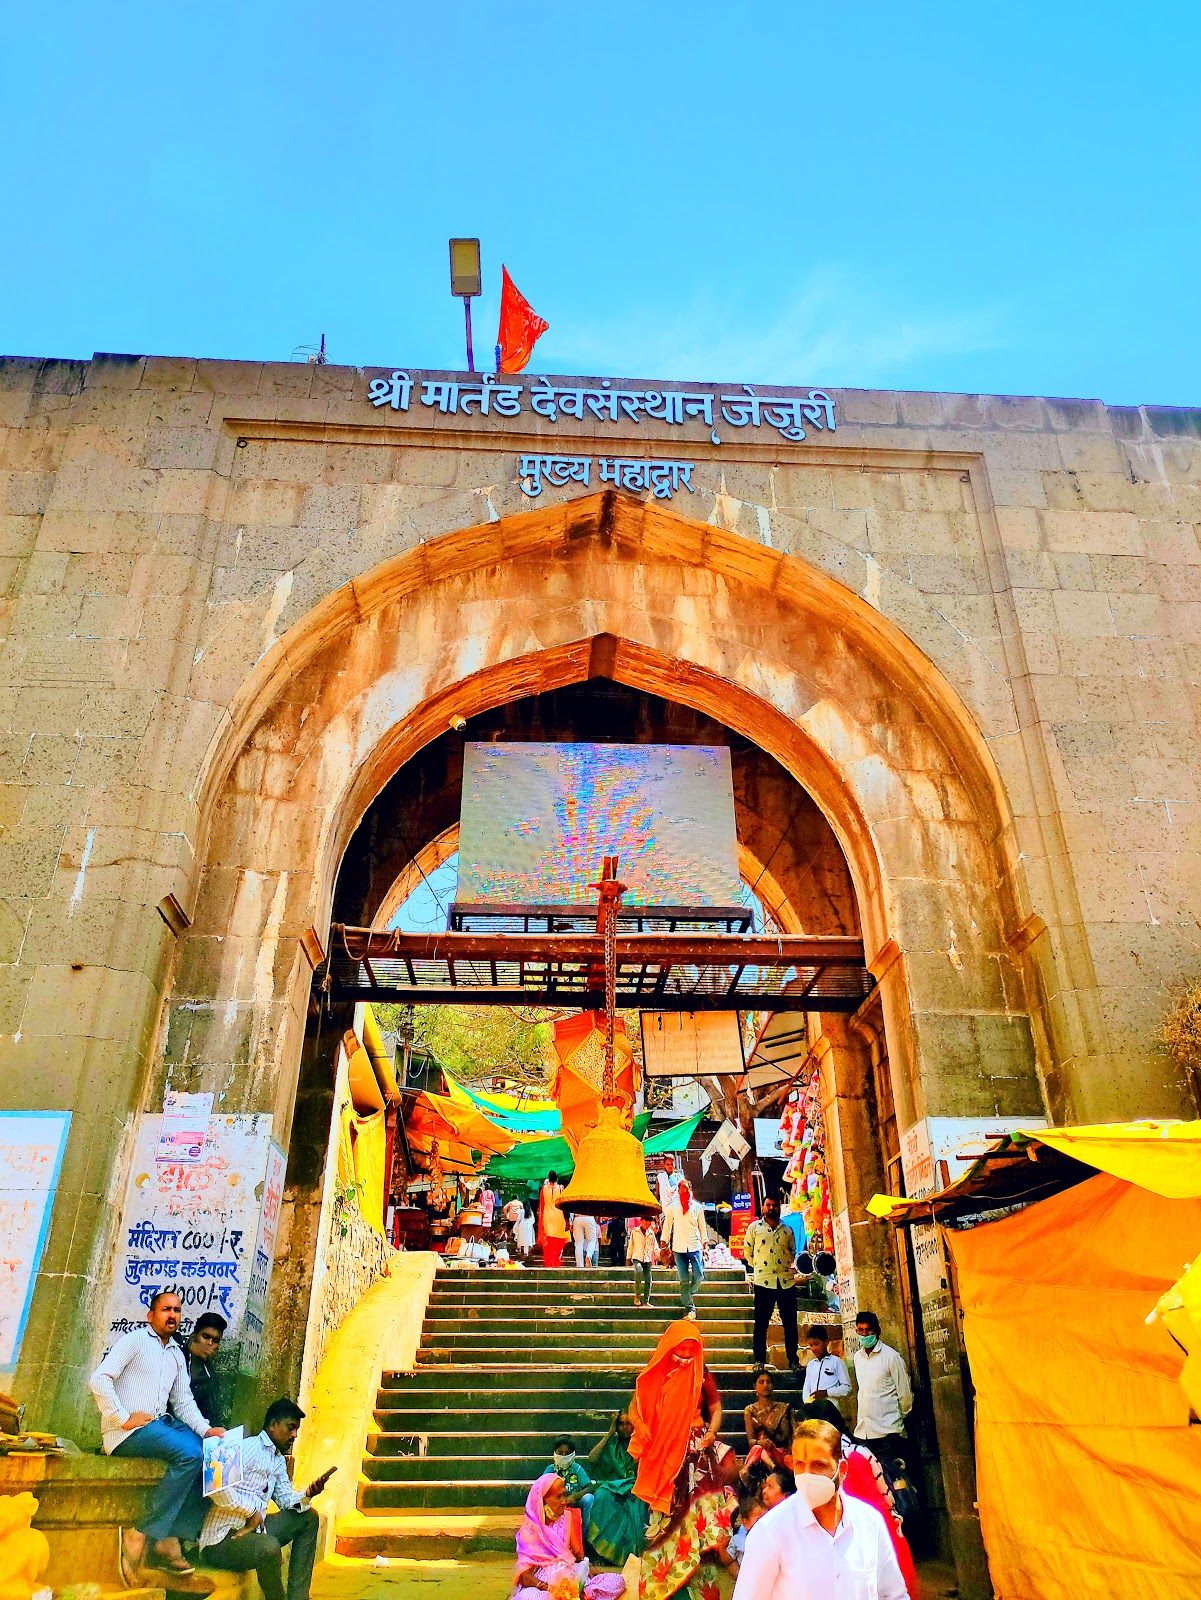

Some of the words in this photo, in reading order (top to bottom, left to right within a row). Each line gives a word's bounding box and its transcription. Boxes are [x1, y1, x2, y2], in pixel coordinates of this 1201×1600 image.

[367, 371, 415, 412] श्री
[420, 372, 523, 416] मार्तंड
[720, 385, 837, 442] जेजुरी
[519, 455, 592, 497] मुख्य
[598, 458, 695, 499] महाद्वार
[181, 1257, 239, 1284] कडेपठार
